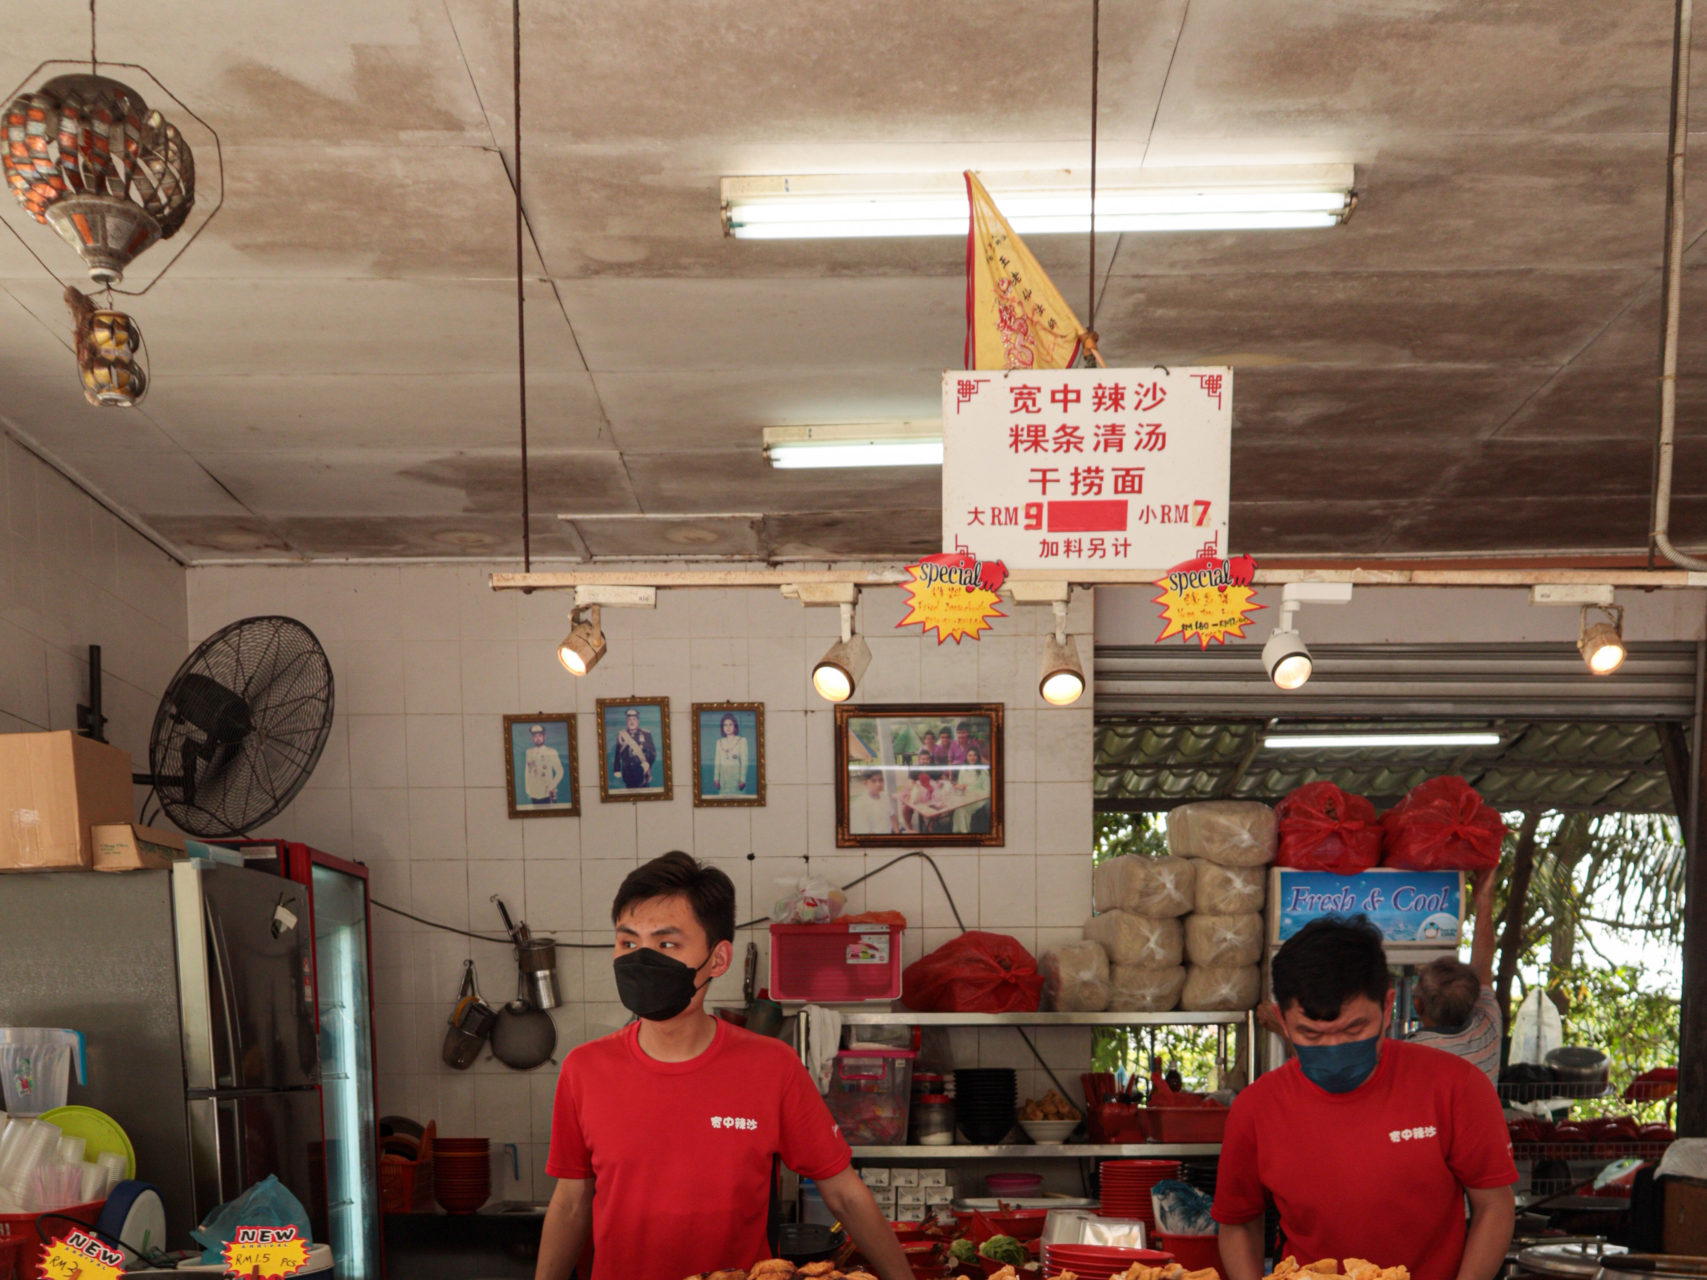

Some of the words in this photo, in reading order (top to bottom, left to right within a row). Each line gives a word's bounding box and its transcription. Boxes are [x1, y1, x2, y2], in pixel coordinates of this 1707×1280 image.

[1009, 382, 1167, 414] 宽中辣沙
[1009, 422, 1167, 454] 粿条清汤
[1028, 466, 1146, 496] 干捞面
[1038, 537, 1132, 559] 加料另计
[1287, 886, 1356, 912] Fresh
[1361, 887, 1384, 911] &
[1391, 886, 1450, 912] Cool
[67, 1232, 122, 1265] NEW
[240, 1228, 295, 1242] NEW
